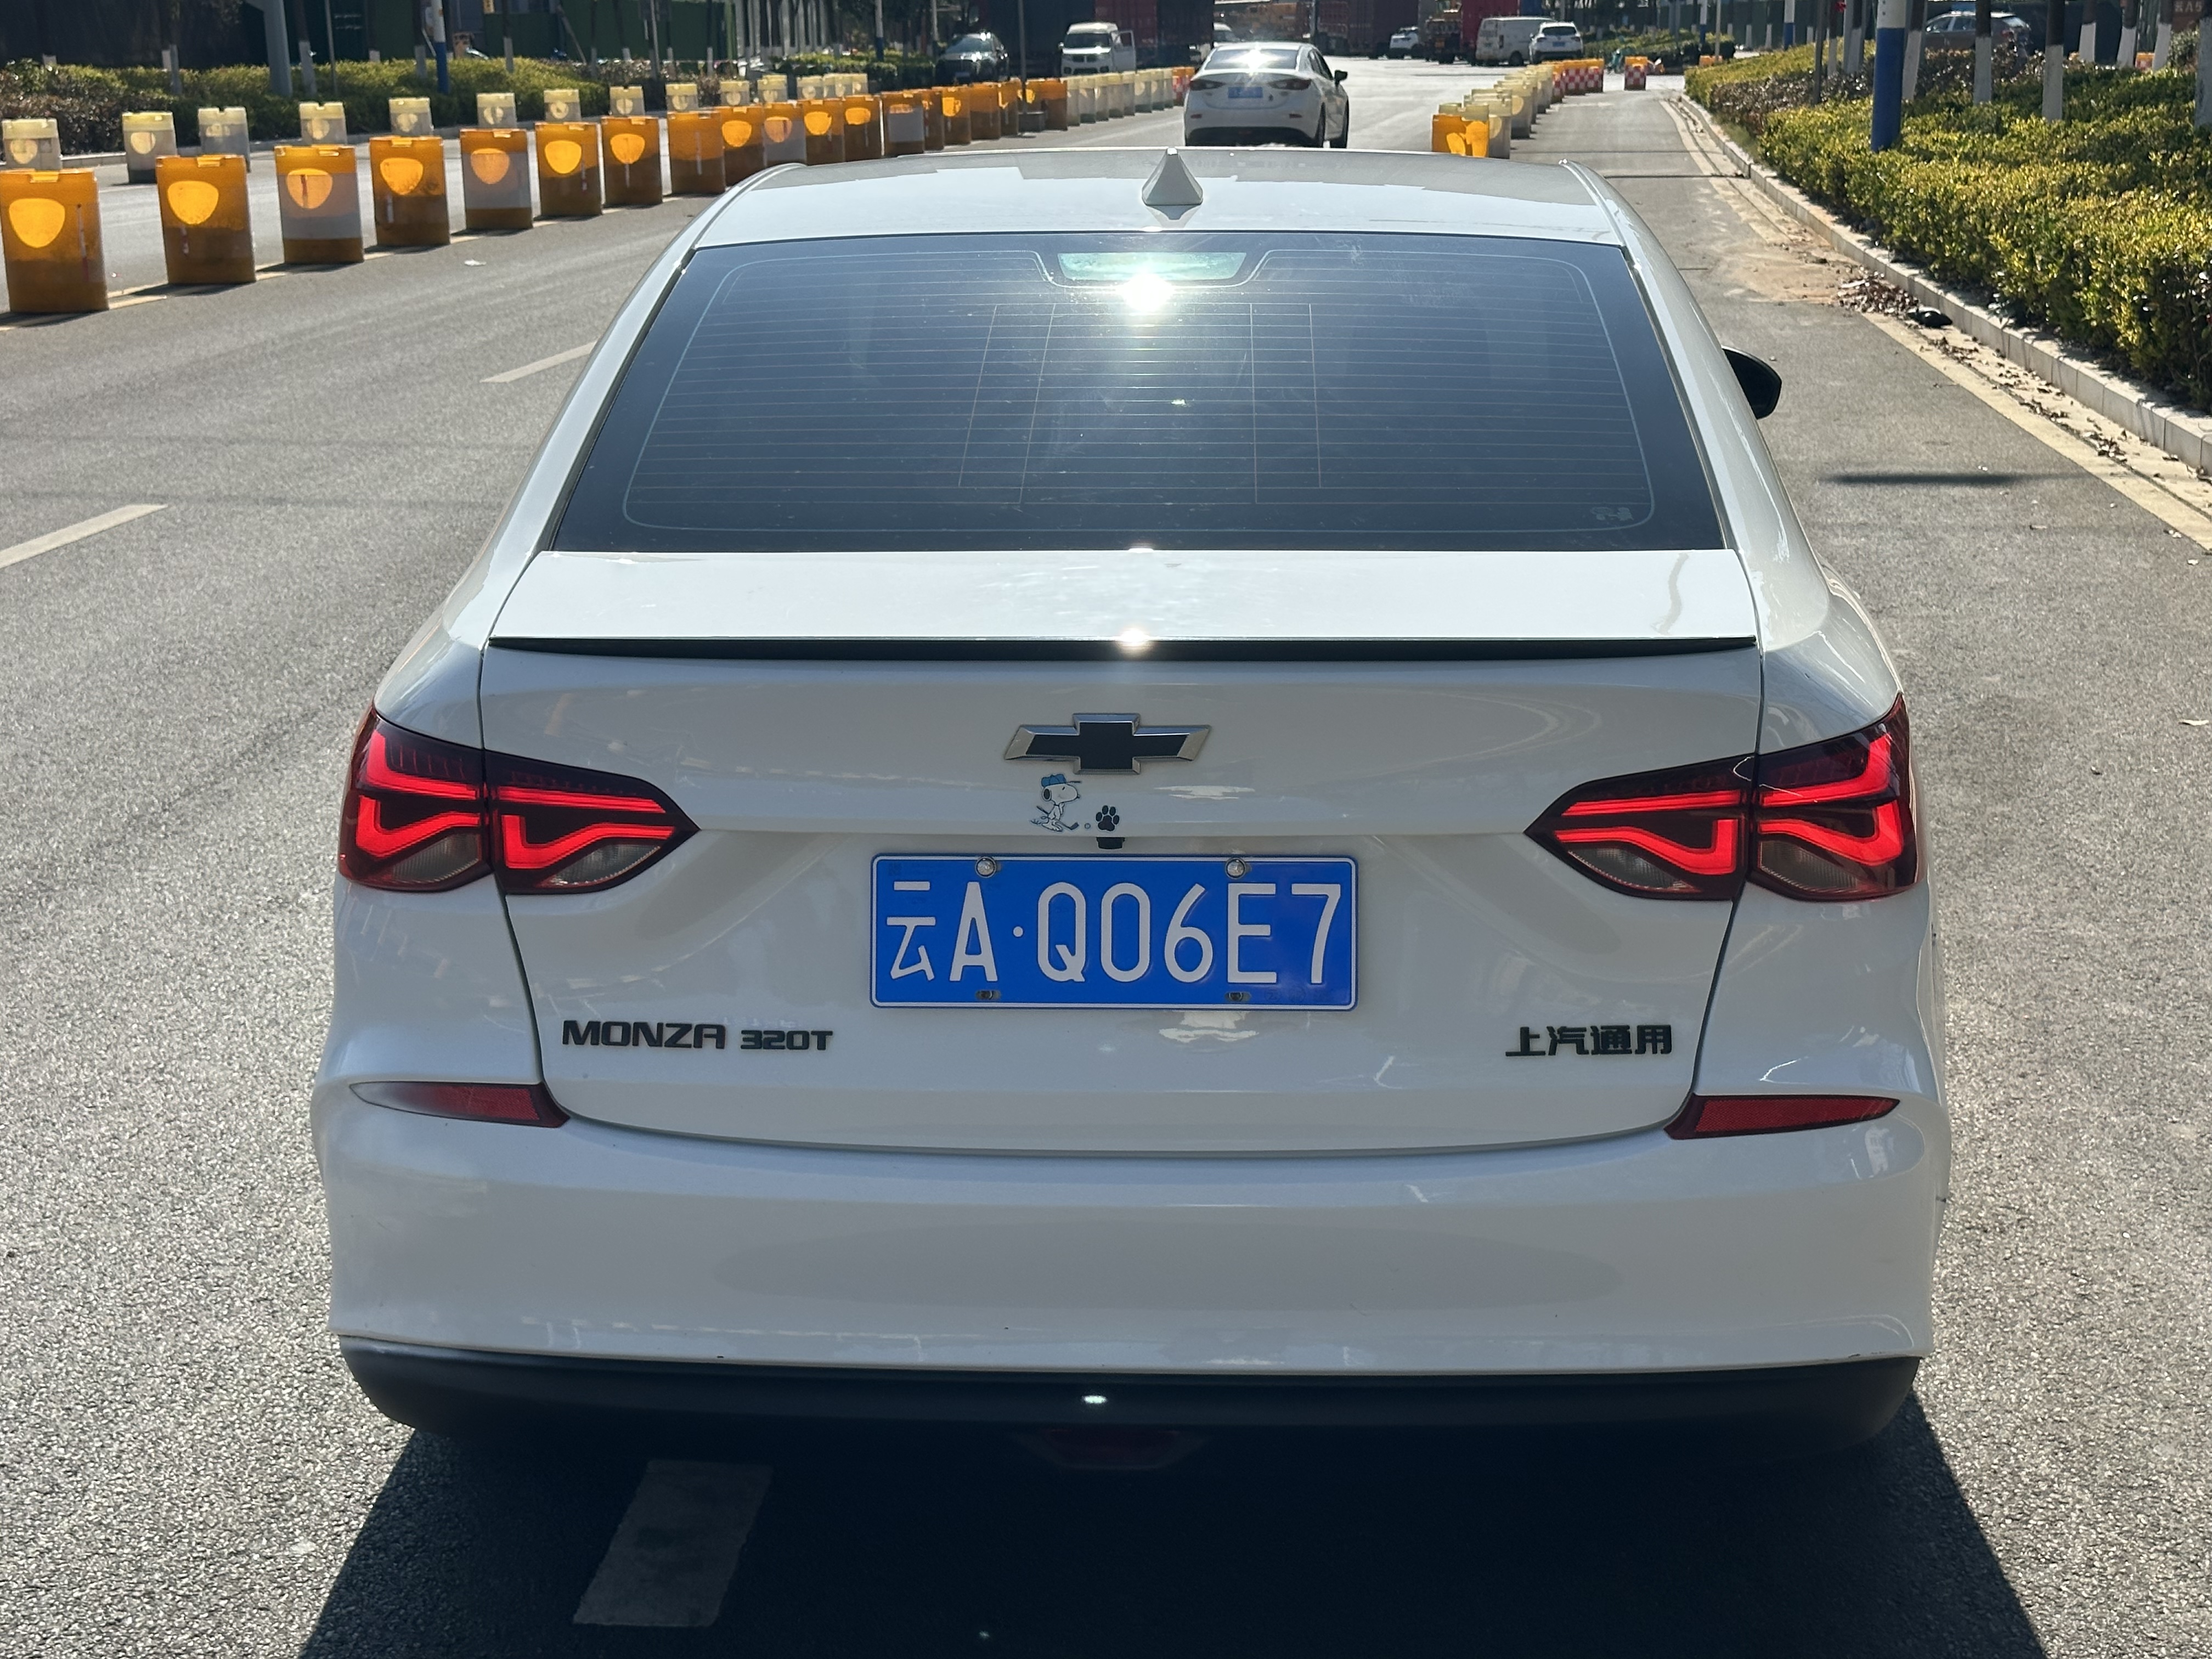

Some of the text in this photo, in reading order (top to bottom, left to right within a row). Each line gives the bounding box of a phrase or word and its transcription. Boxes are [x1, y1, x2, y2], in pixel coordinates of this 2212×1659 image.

[886, 881, 1341, 985] 云A·Q06E7
[562, 1019, 834, 1051] MONZA 320T
[1505, 1024, 1672, 1057] 上汽通用
